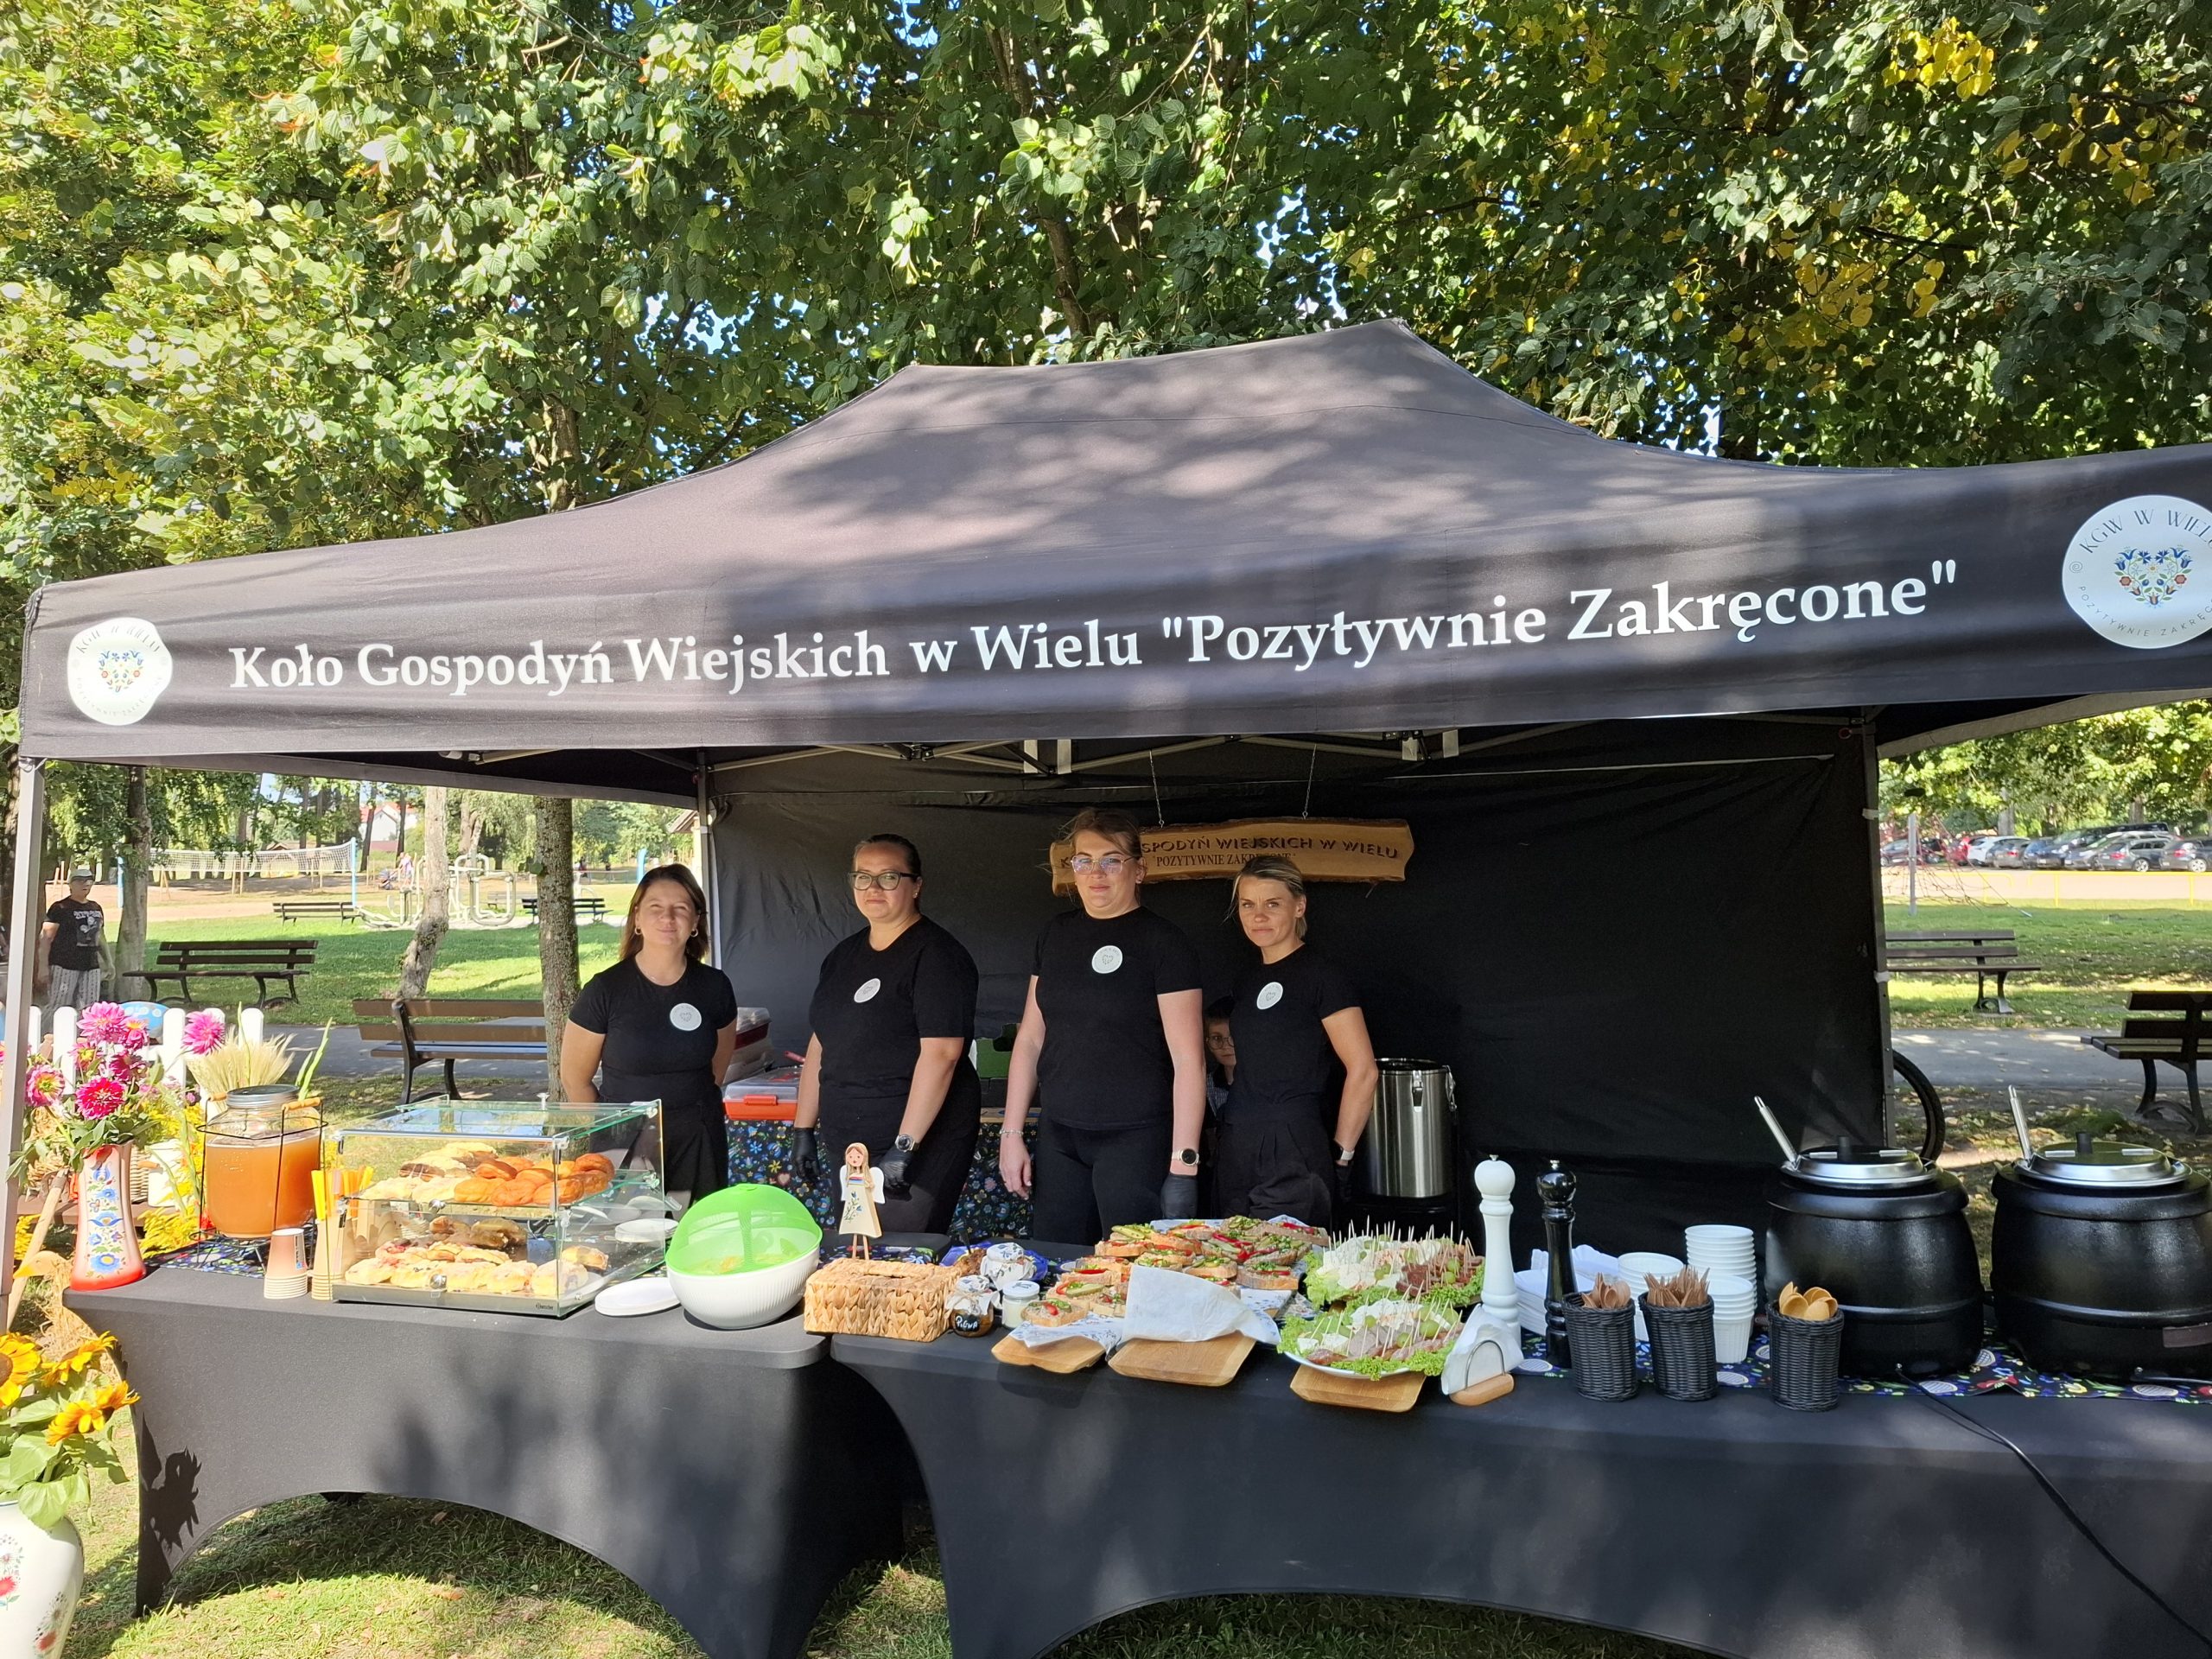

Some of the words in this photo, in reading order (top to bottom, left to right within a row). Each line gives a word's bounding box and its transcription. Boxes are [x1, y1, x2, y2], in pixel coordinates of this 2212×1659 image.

[2079, 515, 2123, 553] KGW
[2134, 509, 2154, 525] W
[228, 643, 343, 689] Koło
[357, 639, 614, 696] Gospodyń
[624, 630, 890, 695] Wiejskich
[910, 639, 958, 673] w
[970, 619, 1142, 671] Wielu
[1162, 594, 1547, 671] "Pozytywnie
[1567, 560, 1958, 643] Zakręcone"
[2079, 585, 2151, 637] POZYTYWNIE
[2160, 599, 2212, 636] ZAKRĘC
[1141, 836, 1210, 853] SPODYŃ
[1216, 836, 1313, 849] WIEJSKICH
[1320, 839, 1336, 849] W
[1343, 840, 1398, 859] WIELU
